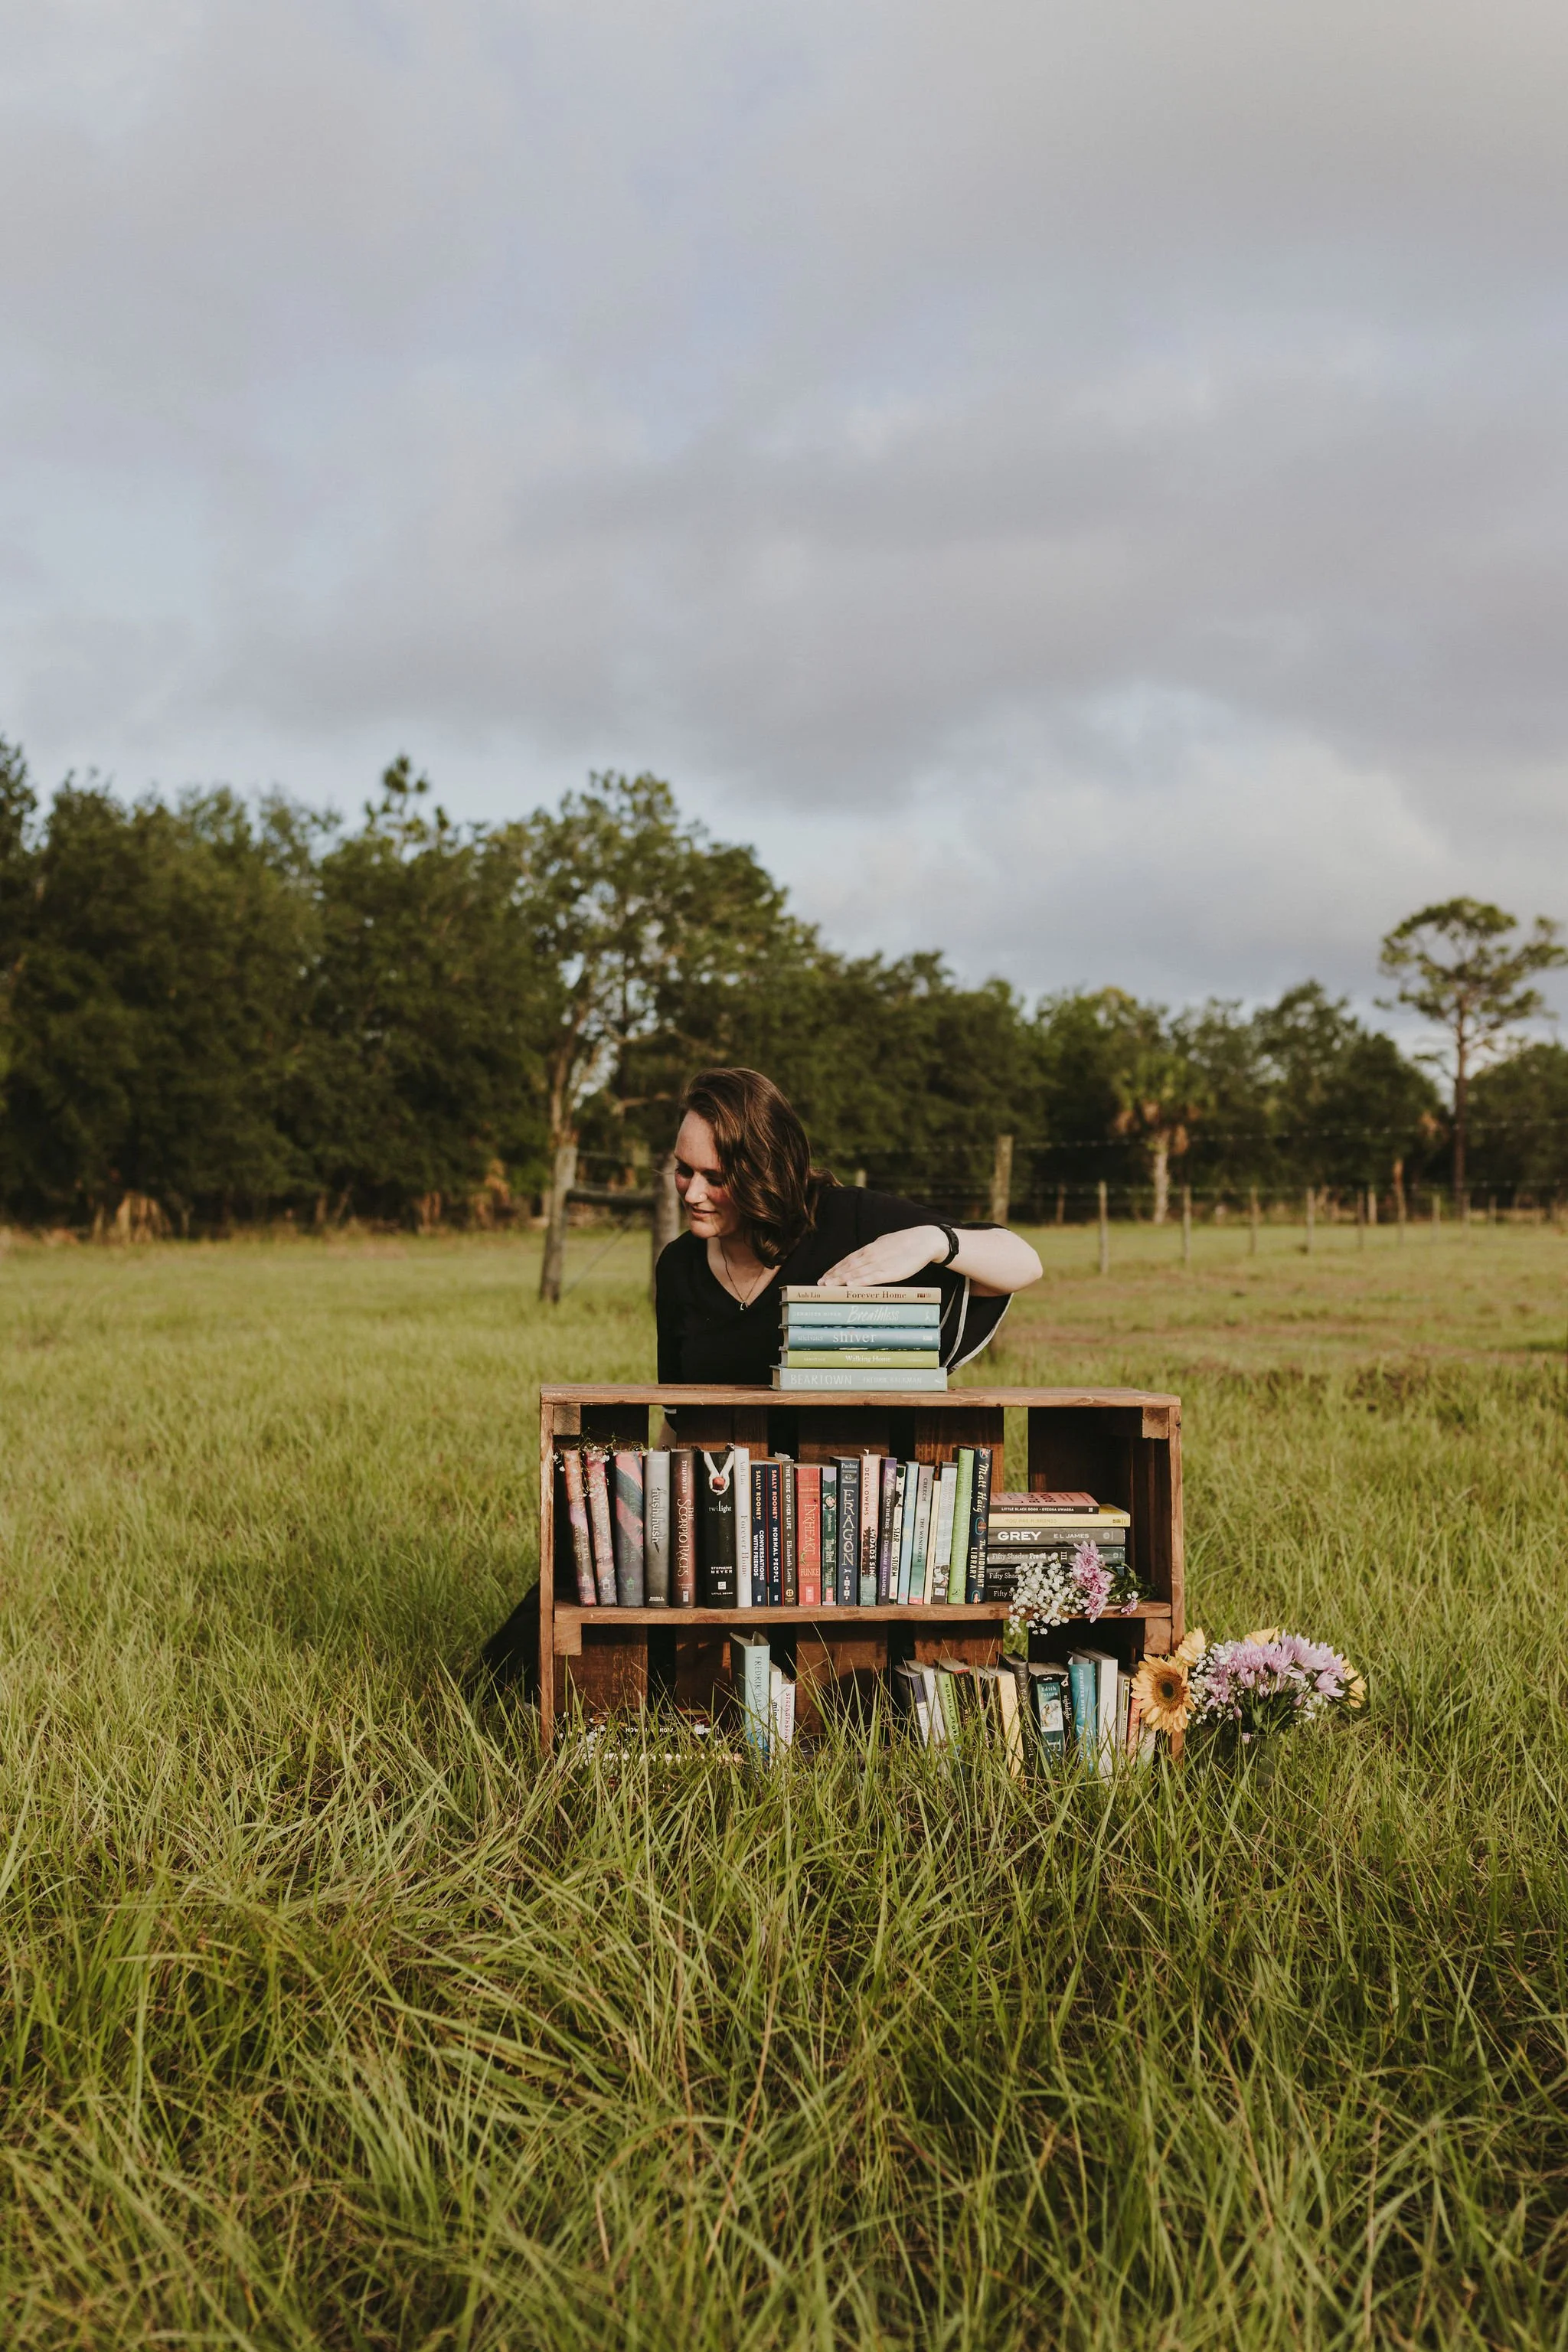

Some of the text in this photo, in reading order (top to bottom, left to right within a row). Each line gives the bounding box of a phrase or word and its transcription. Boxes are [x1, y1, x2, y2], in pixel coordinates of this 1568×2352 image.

[846, 1290, 880, 1298] Forever
[847, 1305, 900, 1323] Breathless
[832, 1331, 876, 1343] shiver
[844, 1354, 871, 1363] Walking
[790, 1374, 852, 1385] BEARTOWN
[957, 1456, 965, 1495] ARMITAGE
[972, 1463, 989, 1513] Matt Haig
[786, 1494, 791, 1503] OF
[651, 1518, 667, 1544] hush
[677, 1498, 692, 1544] SCORPIO
[740, 1515, 749, 1550] Forever
[802, 1503, 818, 1555] INKHEART
[841, 1489, 856, 1566] ERAGON
[998, 1531, 1042, 1541] GREY
[957, 1501, 969, 1579] WALKING HOME
[675, 1544, 689, 1577] RACES
[800, 1567, 819, 1577] FUNKE
[969, 1547, 978, 1579] LIBRARY
[977, 1551, 986, 1588] MIDNIGHT
[754, 1656, 763, 1690] FREDRIK
[945, 1684, 953, 1713] NORMAL
[1062, 1694, 1072, 1720] nightlight
